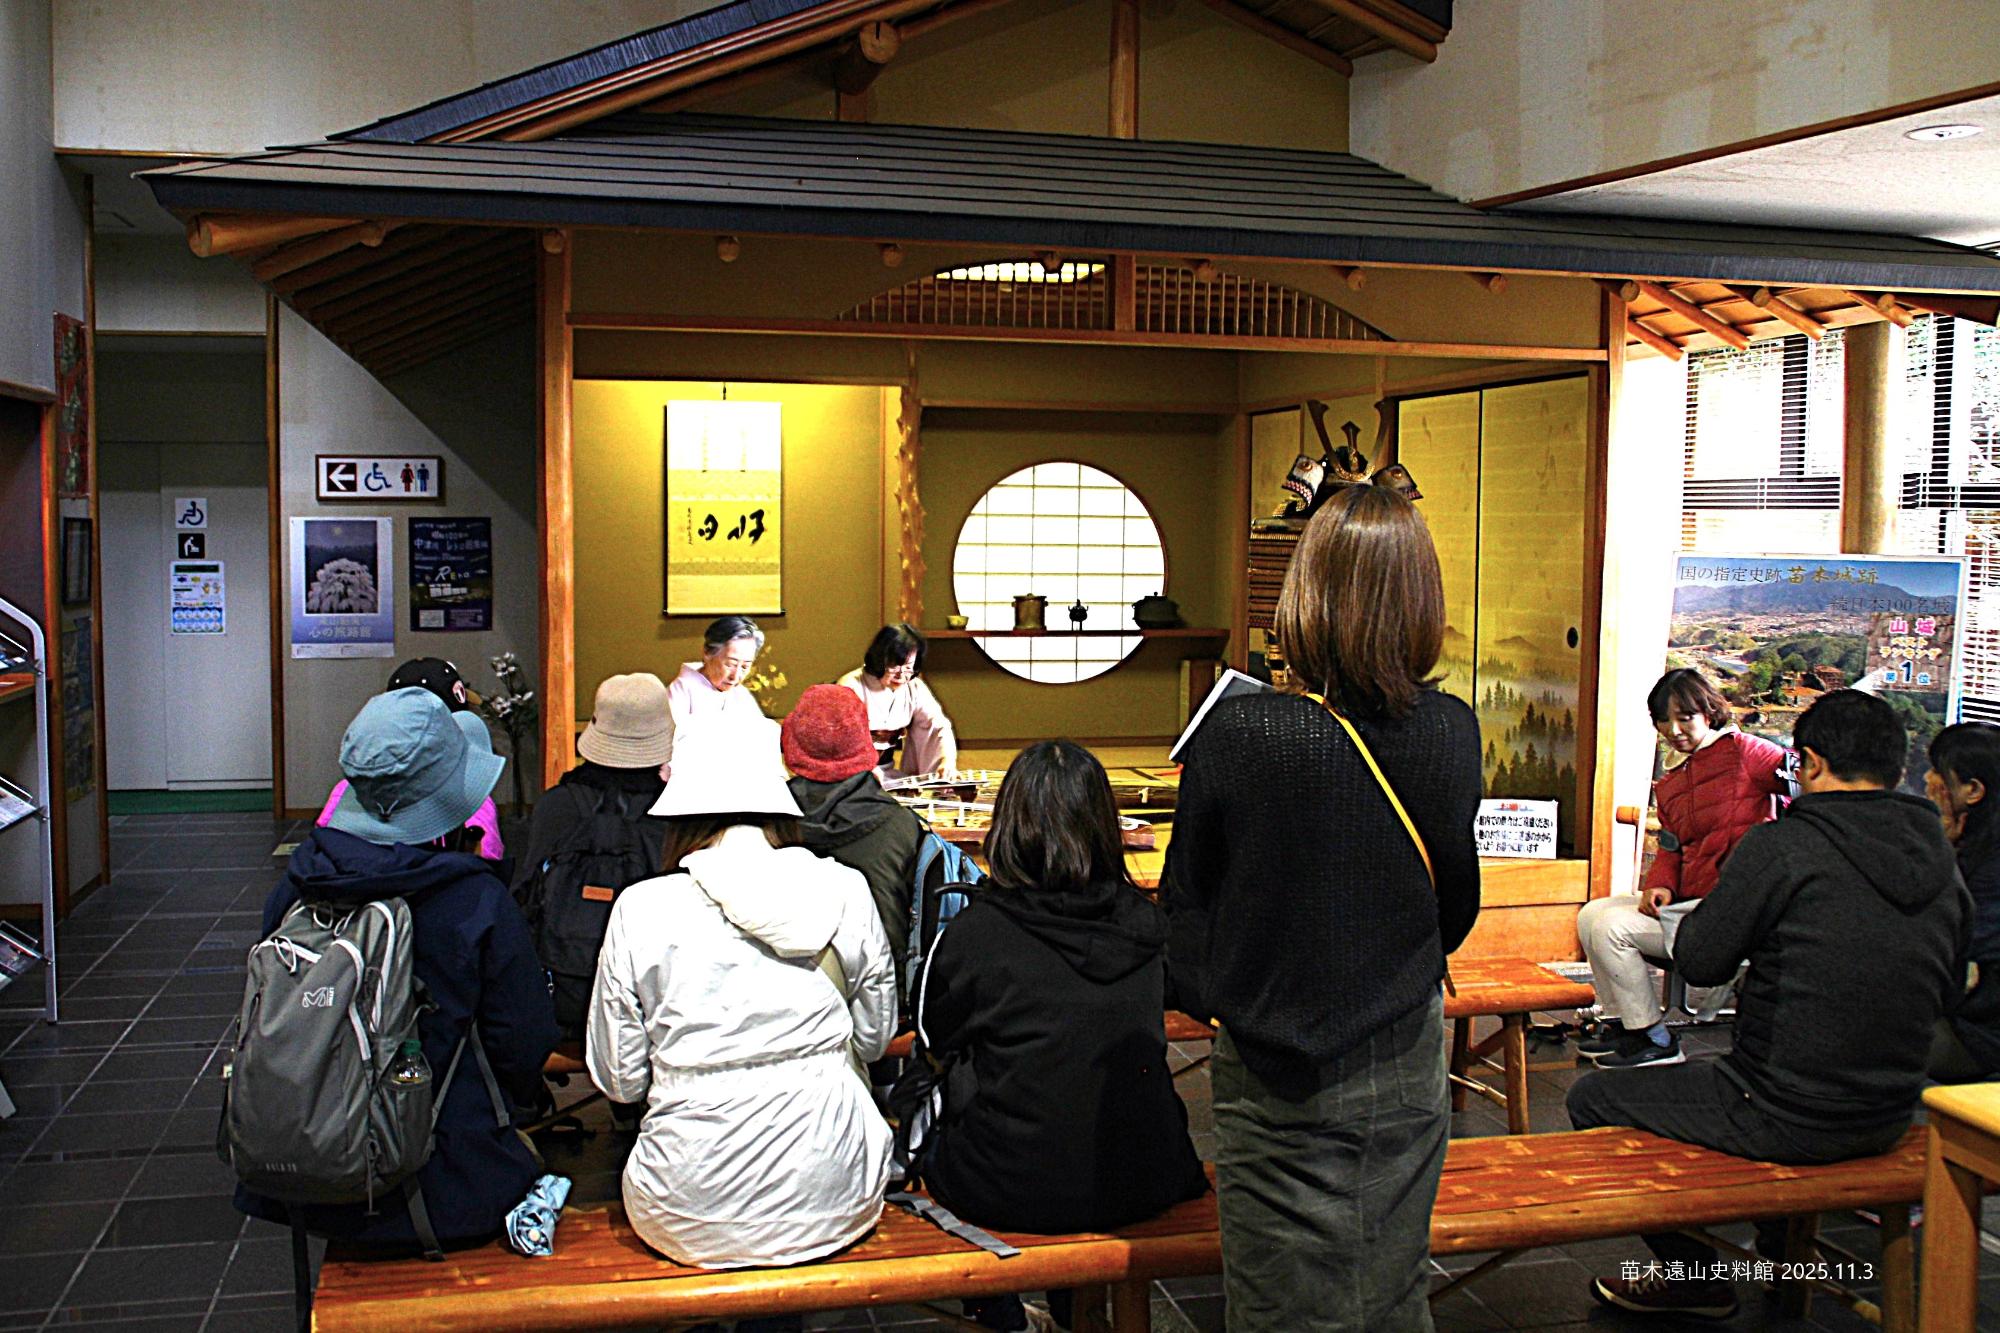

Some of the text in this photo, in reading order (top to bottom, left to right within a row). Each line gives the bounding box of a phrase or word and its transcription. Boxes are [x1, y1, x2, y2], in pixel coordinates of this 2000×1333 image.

[1680, 566, 1879, 585] 国の指定史跡 苗木城跡
[1891, 637, 1928, 648] ベスト
[1880, 646, 1942, 660] ランキング
